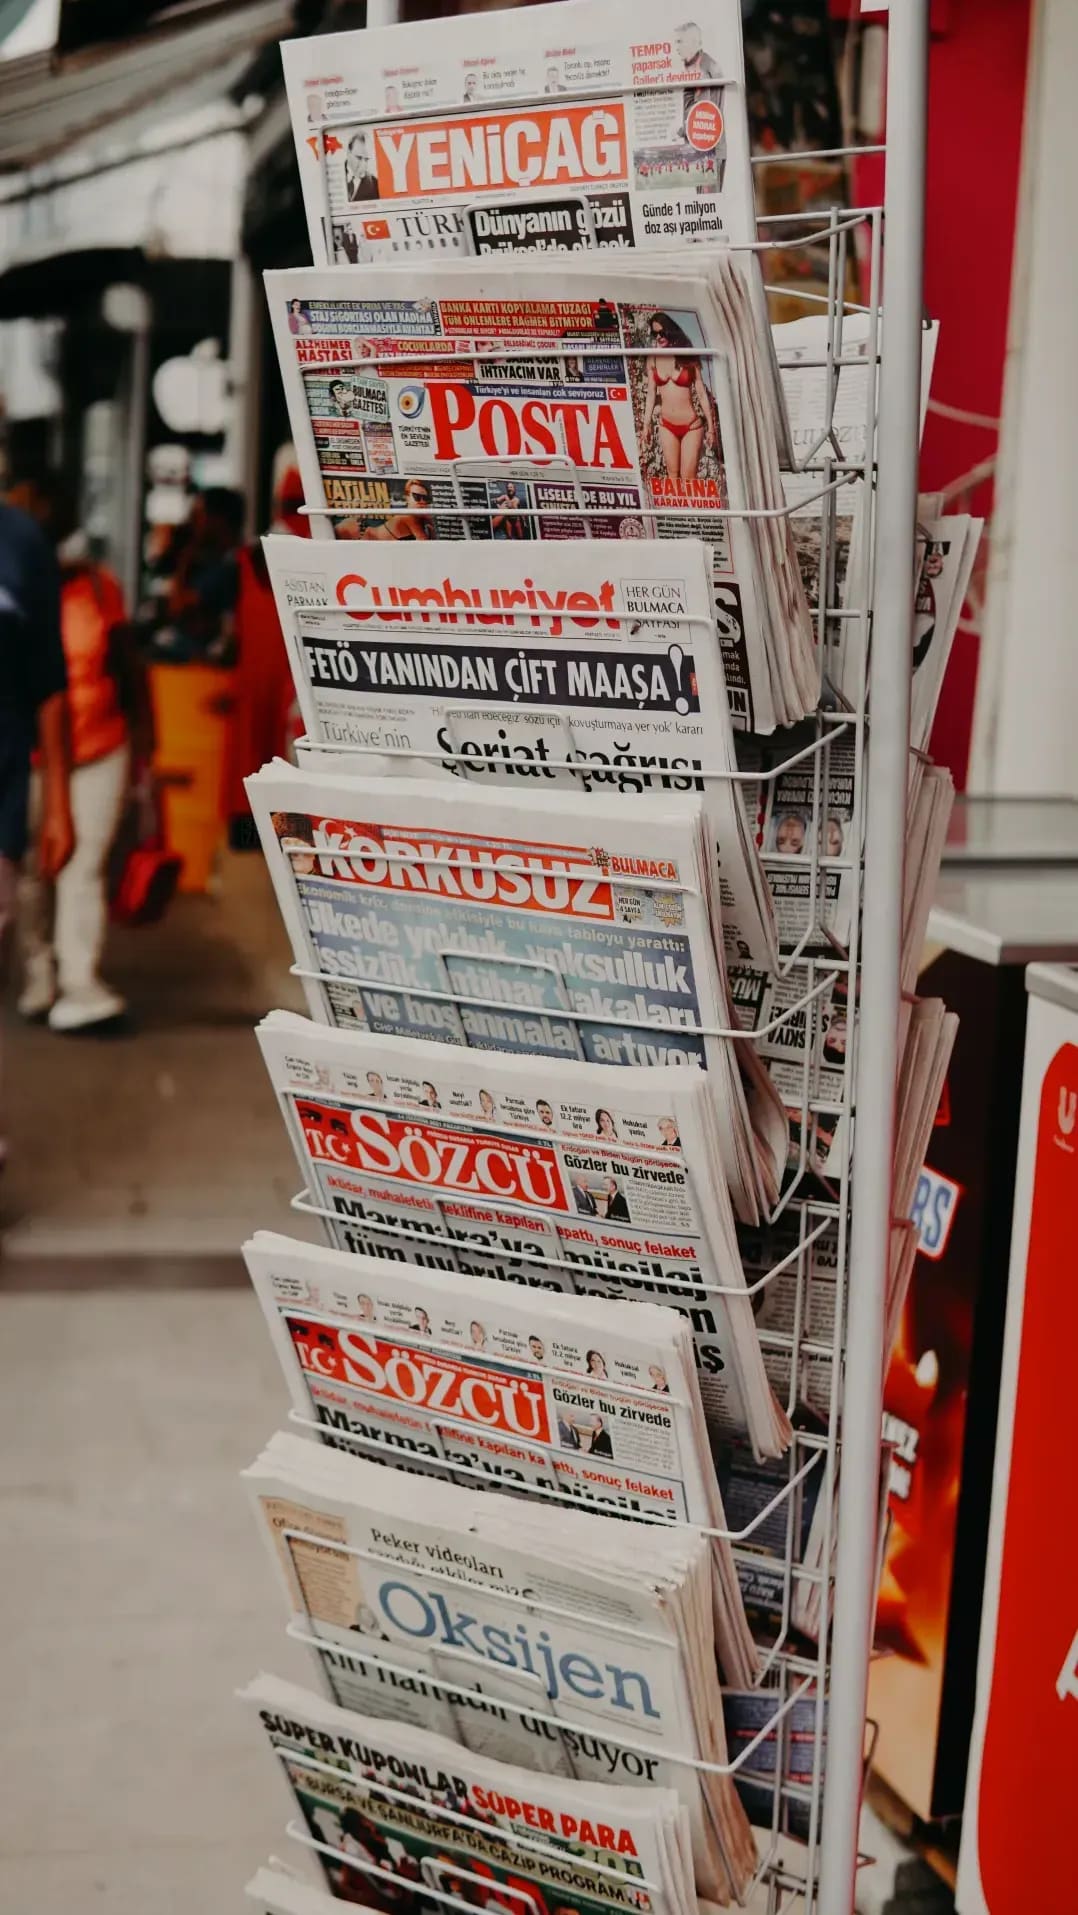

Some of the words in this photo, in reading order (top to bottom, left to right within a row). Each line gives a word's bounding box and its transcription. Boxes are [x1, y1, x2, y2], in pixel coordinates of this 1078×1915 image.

[629, 42, 672, 58] TEMPO
[631, 58, 672, 73] yaparsak
[474, 209, 572, 240] Dünyanın
[576, 200, 628, 236] gözü
[642, 203, 673, 218] Günde
[676, 202, 681, 216] 1
[684, 201, 717, 217] milyon
[644, 221, 662, 235] doz
[664, 222, 677, 237] aşı
[679, 216, 723, 236] yapılmalı
[440, 303, 472, 314] BANKA
[473, 303, 499, 314] KARTI
[502, 303, 557, 315] KOPYALAMA
[557, 303, 592, 315] TUZAĞI
[444, 315, 461, 325] TÜM
[463, 315, 512, 326] ÖNLEMLERE
[549, 317, 593, 328] BİTMİYOR
[299, 350, 353, 362] HASTASI
[481, 364, 538, 380] İHTİYACIM
[539, 367, 561, 381] VAR
[353, 385, 386, 402] BULMACA
[475, 385, 509, 395] Türkiye'yi
[552, 388, 567, 397] çok
[568, 389, 605, 399] seviyoruz
[353, 398, 387, 415] GAZETESİ
[424, 382, 634, 469] POSTA
[324, 479, 390, 501] TATİLİN
[537, 488, 598, 503] LİSELEDE
[598, 492, 615, 504] BU
[616, 493, 637, 507] YIL
[650, 477, 720, 497] BALİNA
[653, 498, 689, 508] KARAYA
[690, 499, 722, 509] VURDU
[335, 573, 621, 636] Cumhuriyet
[626, 586, 649, 598] HER
[651, 584, 681, 598] GÜN
[628, 601, 685, 614] BULMACA
[304, 639, 359, 683] FETÖ
[360, 650, 498, 692] YANINDAN
[504, 650, 557, 702] ÇİFT
[567, 643, 690, 716] MAAŞA!
[320, 721, 412, 749] Türkiye'nin
[634, 723, 650, 734] yer
[675, 723, 704, 736] kararı
[437, 727, 557, 779] Şeriat
[566, 741, 706, 793] çağrısı
[312, 829, 612, 917] KORKUSUZ
[611, 856, 677, 879] BULMACA
[568, 926, 624, 946] tabloyu
[627, 935, 685, 953] yarattı:
[526, 942, 691, 994] yoksulluk
[362, 992, 400, 1021] ve
[350, 1108, 557, 1206] SÖZCÜ
[564, 1154, 608, 1172] Gözler
[612, 1161, 630, 1176] bu
[632, 1167, 685, 1185] zirvede
[496, 1211, 545, 1232] kapıları
[600, 1234, 642, 1255] sonuç
[644, 1241, 697, 1259] felaket
[338, 1329, 542, 1437] SÖZCÜ
[553, 1388, 595, 1410] Gözler
[599, 1399, 616, 1416] bu
[620, 1406, 671, 1428] zirvede
[581, 1468, 623, 1489] sonuç
[625, 1478, 675, 1501] felaket
[370, 1528, 420, 1553] Peker
[425, 1544, 504, 1579] videoları
[378, 1581, 662, 1720] Oksijen
[259, 1709, 338, 1754] SÜPER
[338, 1735, 468, 1799] KUPONLAR
[472, 1785, 557, 1834] SÜPER
[560, 1812, 638, 1857] PARA
[539, 1861, 625, 1902] PROGRAM
